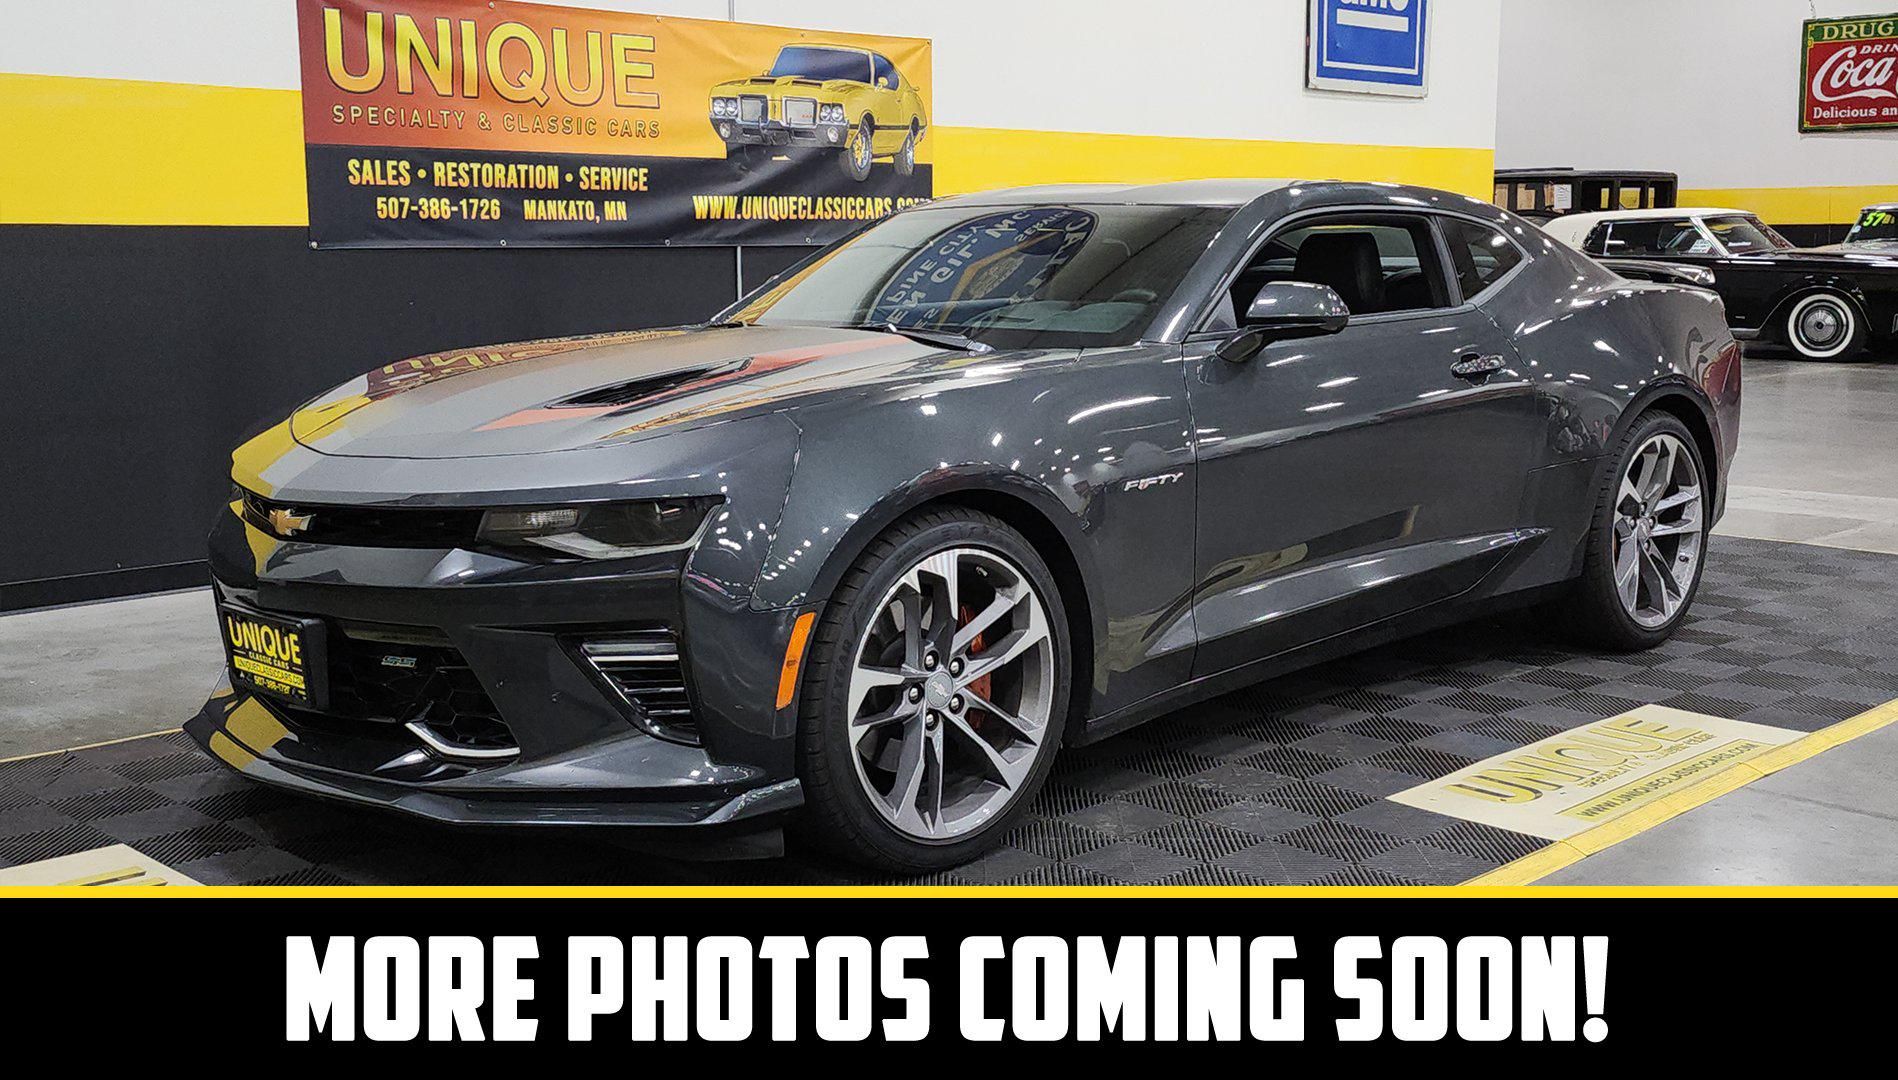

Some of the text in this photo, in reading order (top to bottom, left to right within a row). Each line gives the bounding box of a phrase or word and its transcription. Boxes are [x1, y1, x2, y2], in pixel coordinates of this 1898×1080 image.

[1822, 21, 1894, 40] DRUG
[323, 7, 661, 109] UNIQUE
[332, 104, 660, 137] SPECIALTY & CLASSIC CARS
[1813, 106, 1877, 119] Delicious
[347, 158, 649, 191] SALES RESTORATION SERVICE
[376, 196, 627, 223] 507-386-1726 MANKATO, MN
[1863, 211, 1886, 227] 57
[1123, 471, 1184, 492] FIFTY
[227, 615, 302, 666] UNIQUE
[1440, 716, 1704, 805] UNIQUE
